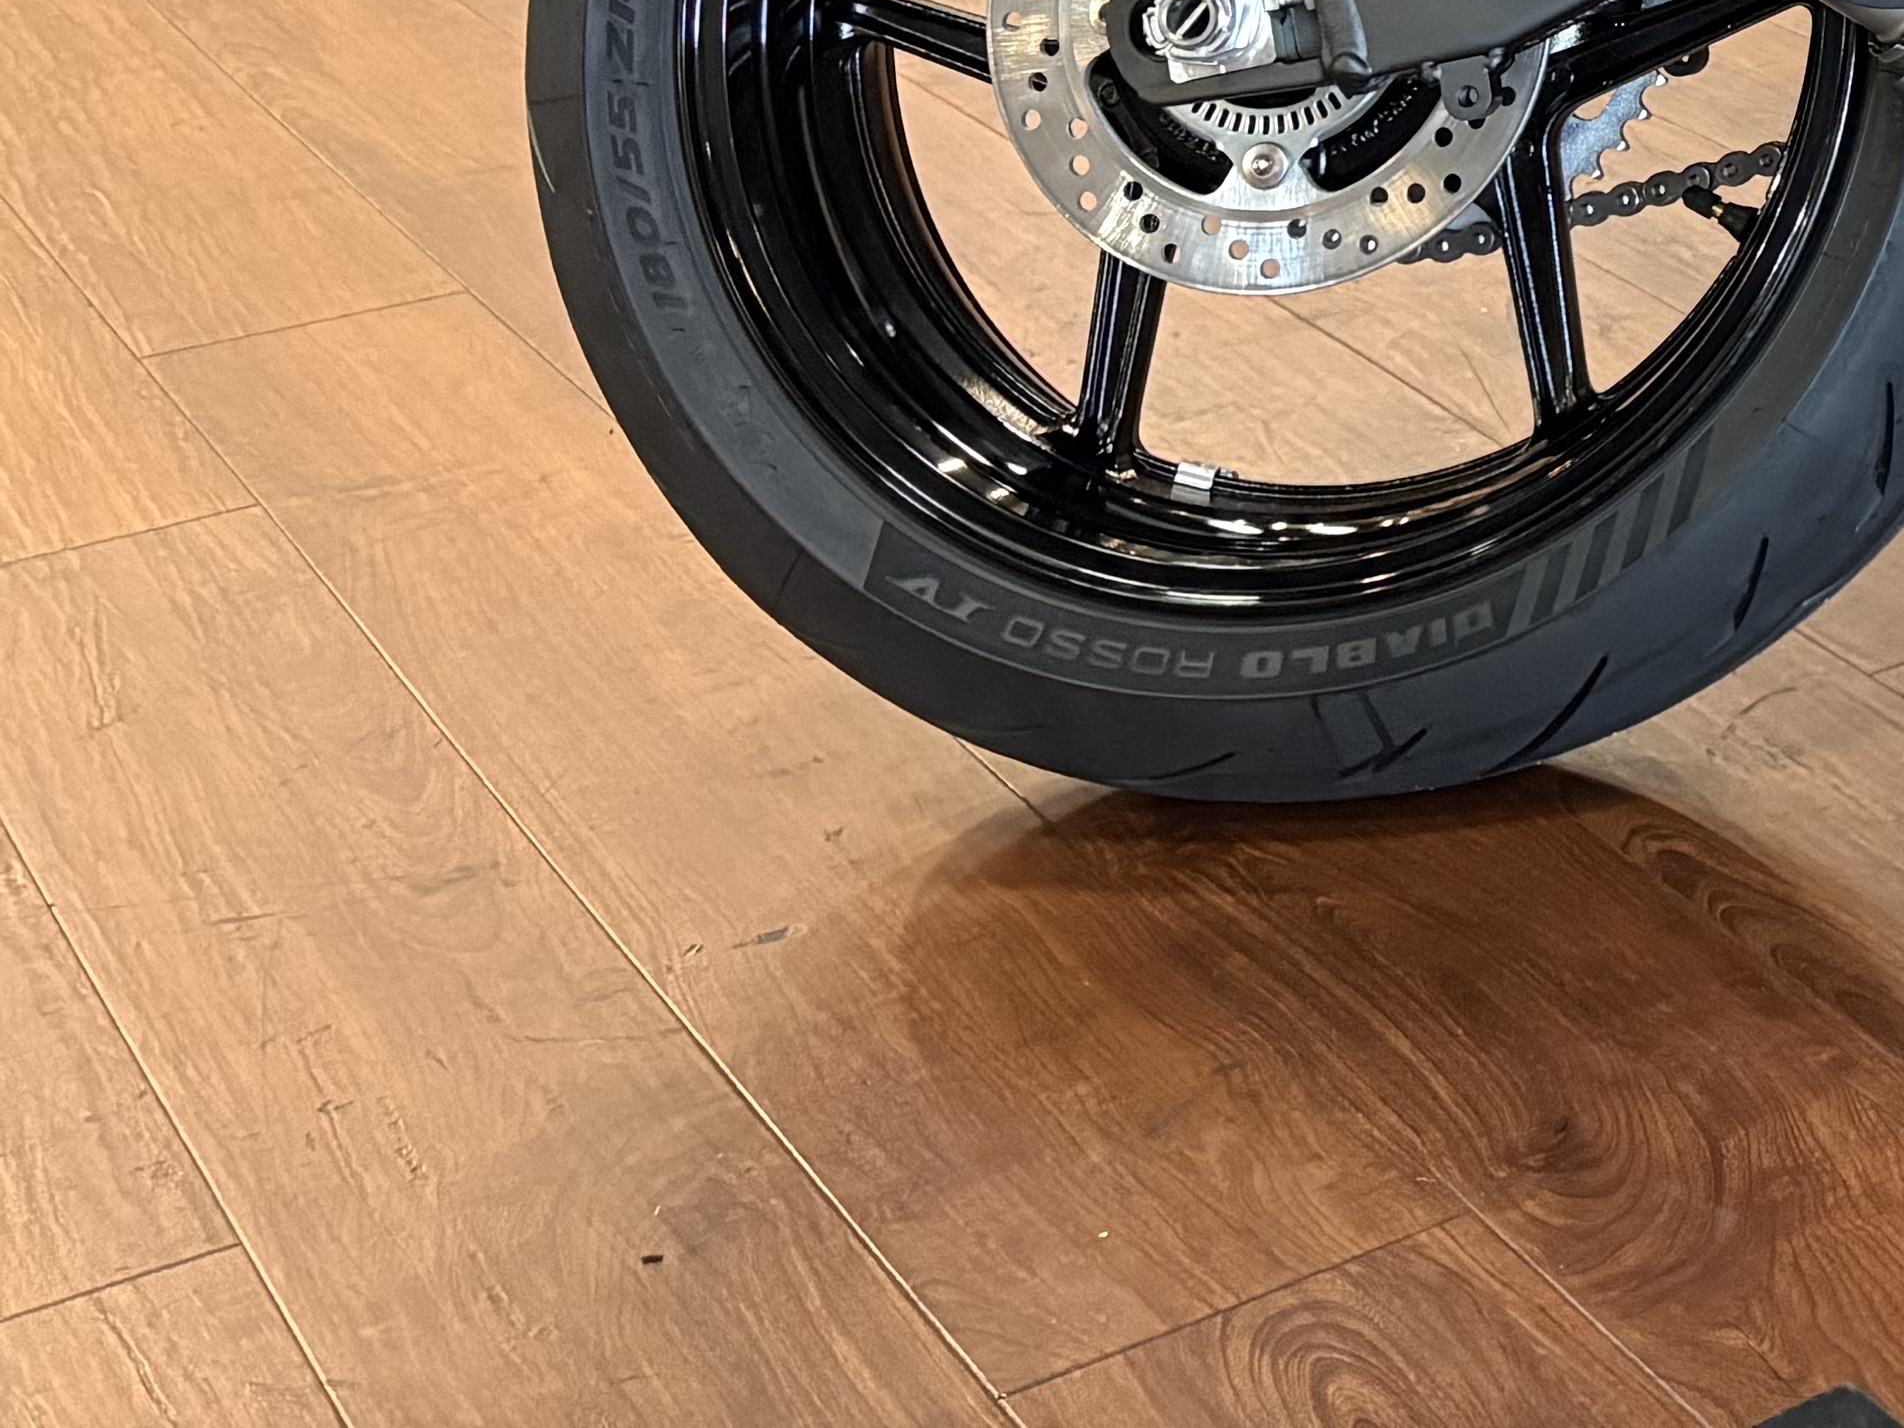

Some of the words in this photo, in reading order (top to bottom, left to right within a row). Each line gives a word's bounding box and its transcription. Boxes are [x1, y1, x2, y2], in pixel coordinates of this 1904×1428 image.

[607, 87, 690, 315] 180/55
[885, 575, 996, 624] IV
[1001, 614, 1217, 680] ROSSO
[1239, 597, 1497, 681] DIABLO
